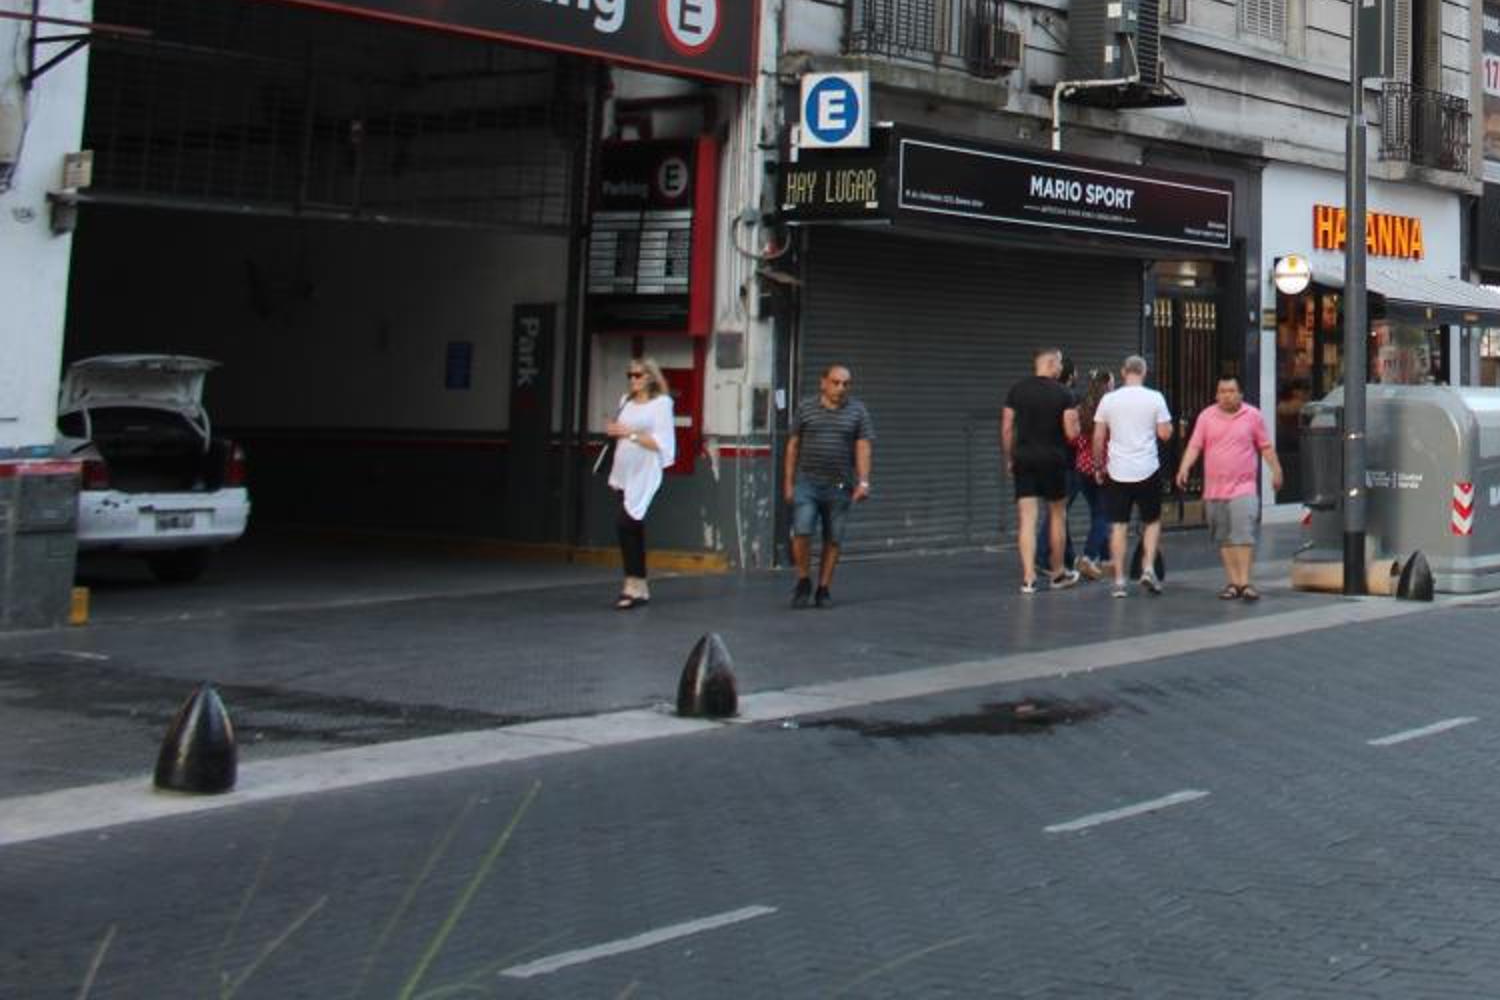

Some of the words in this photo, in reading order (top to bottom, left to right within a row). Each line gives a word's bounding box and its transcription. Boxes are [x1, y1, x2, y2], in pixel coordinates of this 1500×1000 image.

[817, 90, 846, 131] E
[666, 164, 679, 191] E
[787, 171, 817, 206] HAY
[825, 168, 878, 204] LUGAR
[1030, 175, 1083, 204] MARIO
[1085, 184, 1135, 209] SPORT
[1313, 204, 1424, 261] HAANNA
